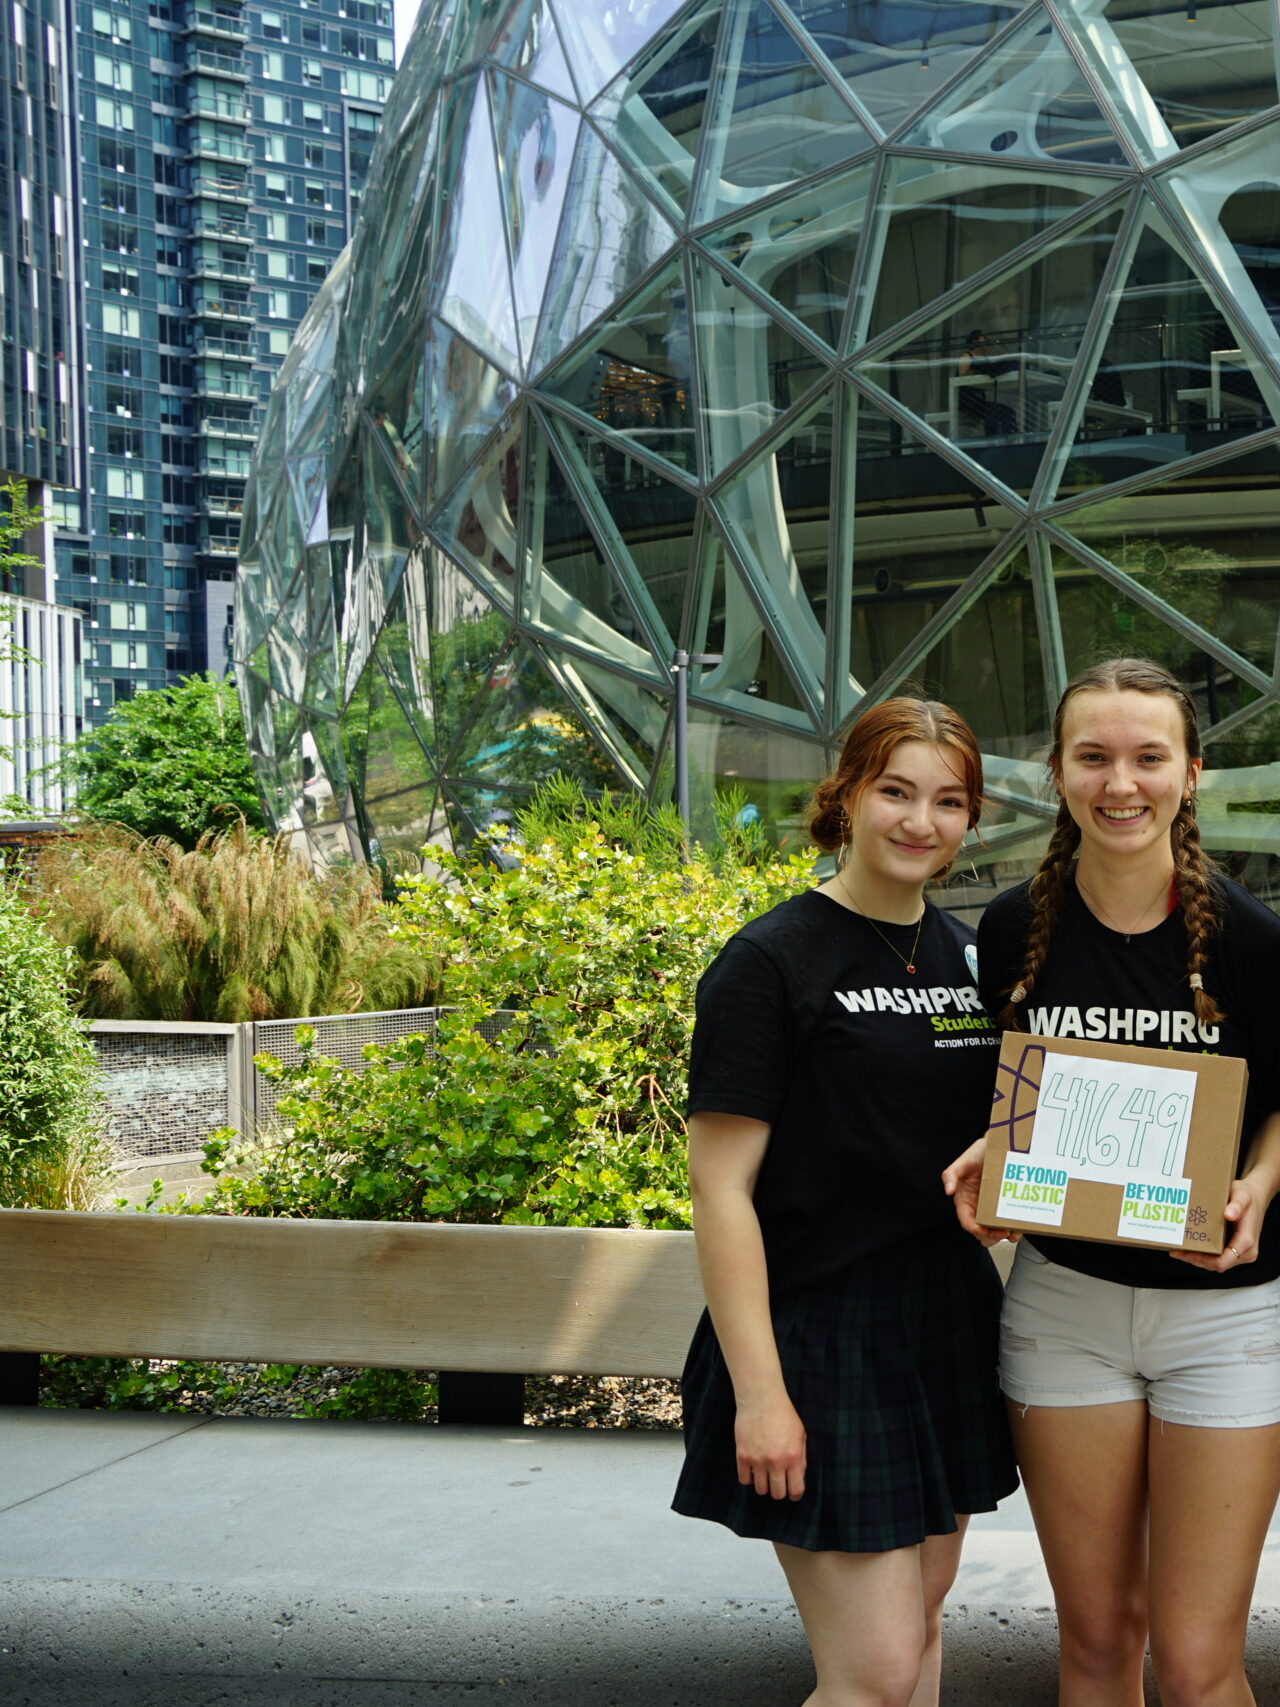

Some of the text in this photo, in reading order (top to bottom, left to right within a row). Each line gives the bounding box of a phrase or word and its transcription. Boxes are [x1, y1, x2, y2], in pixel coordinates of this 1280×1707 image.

[834, 986, 985, 1014] WASHPIR
[1028, 1006, 1220, 1044] WASHPIRG
[934, 1039, 963, 1049] ACTION
[964, 1038, 981, 1048] FOR
[981, 1038, 988, 1046] A
[1042, 1072, 1189, 1176] 41,649
[1004, 1163, 1068, 1187] BEYOND
[1002, 1181, 1065, 1206] PLASTIC
[1125, 1182, 1188, 1206] BEYOND
[1122, 1200, 1186, 1225] PLASTIC
